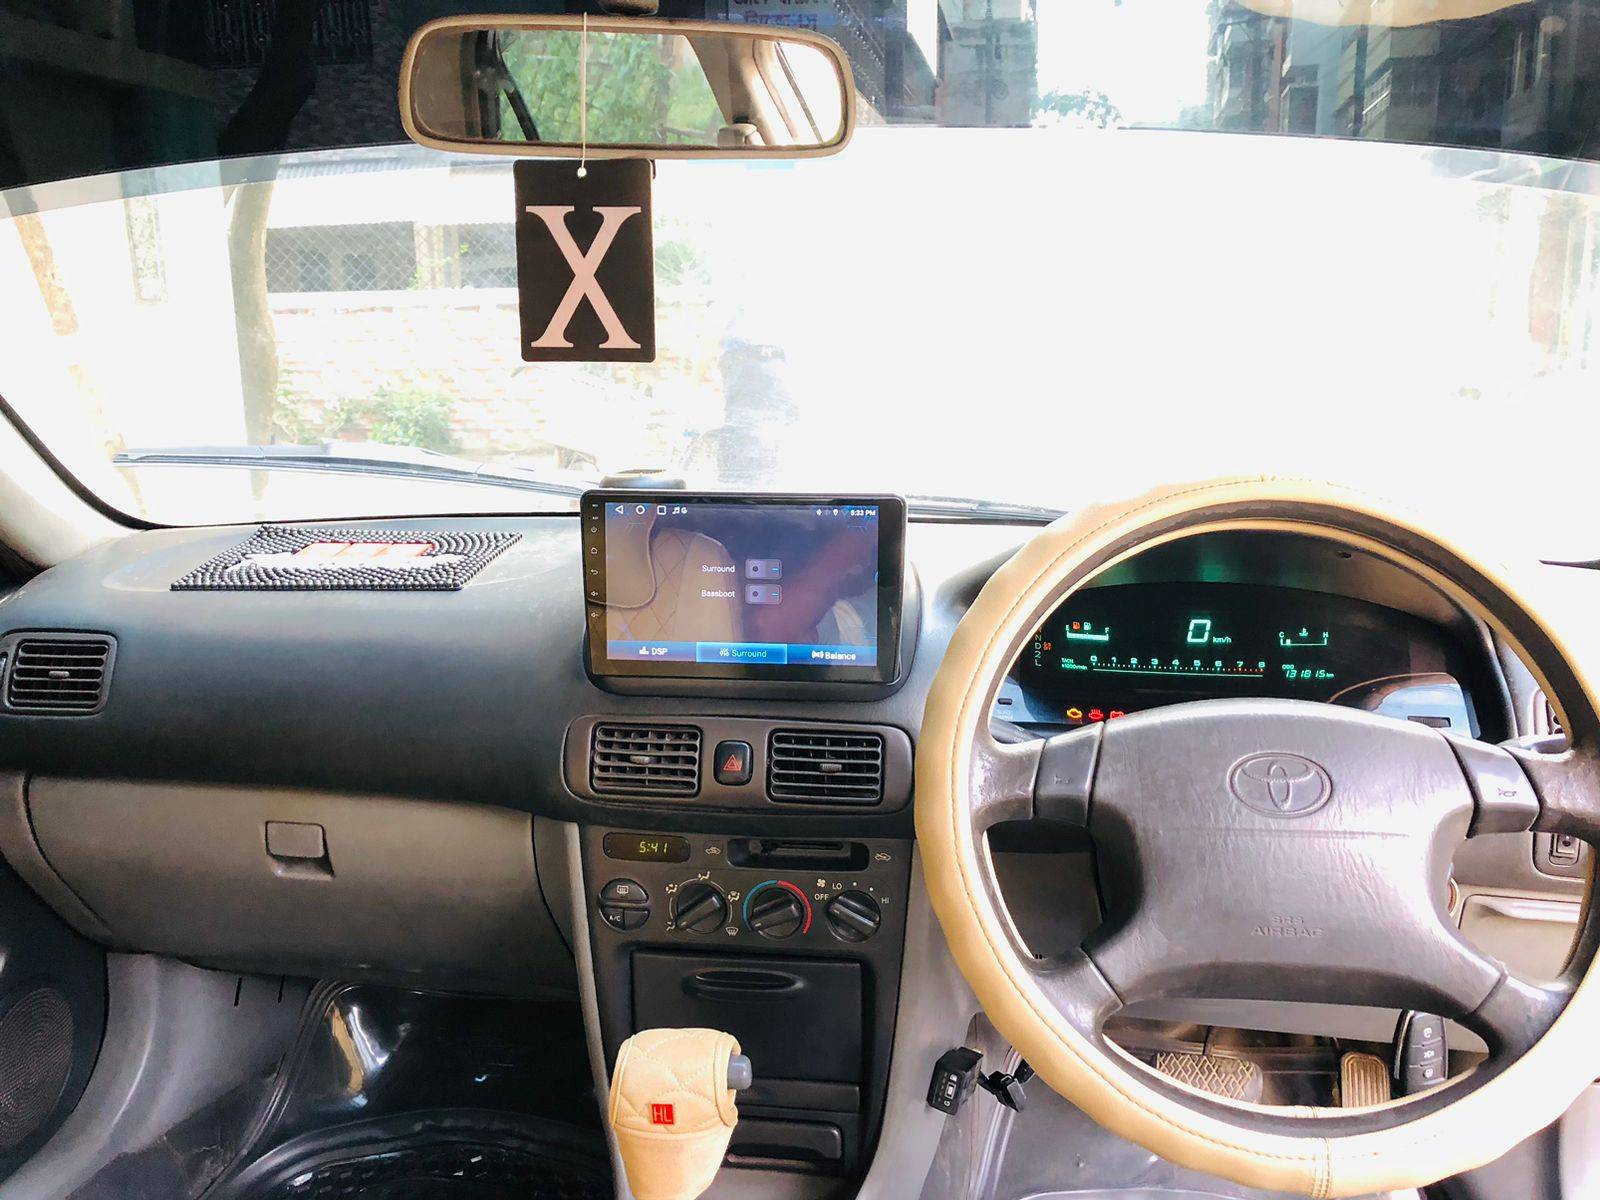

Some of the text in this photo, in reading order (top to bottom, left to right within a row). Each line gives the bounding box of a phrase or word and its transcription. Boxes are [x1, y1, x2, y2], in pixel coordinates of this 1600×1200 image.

[525, 205, 642, 349] X
[701, 564, 736, 573] Surround
[701, 589, 736, 598] Bassboot
[1186, 618, 1232, 644] 0 km/h
[1034, 642, 1042, 650] D
[651, 647, 668, 655] DSP
[731, 649, 767, 658] Surround
[1034, 650, 1041, 659] 2
[825, 651, 857, 661] Balance
[1034, 659, 1042, 667] L
[639, 841, 668, 853] 5:41
[832, 882, 843, 890] LO
[814, 893, 829, 901] OFF
[609, 914, 622, 922] A/C
[653, 1105, 672, 1122] HL
